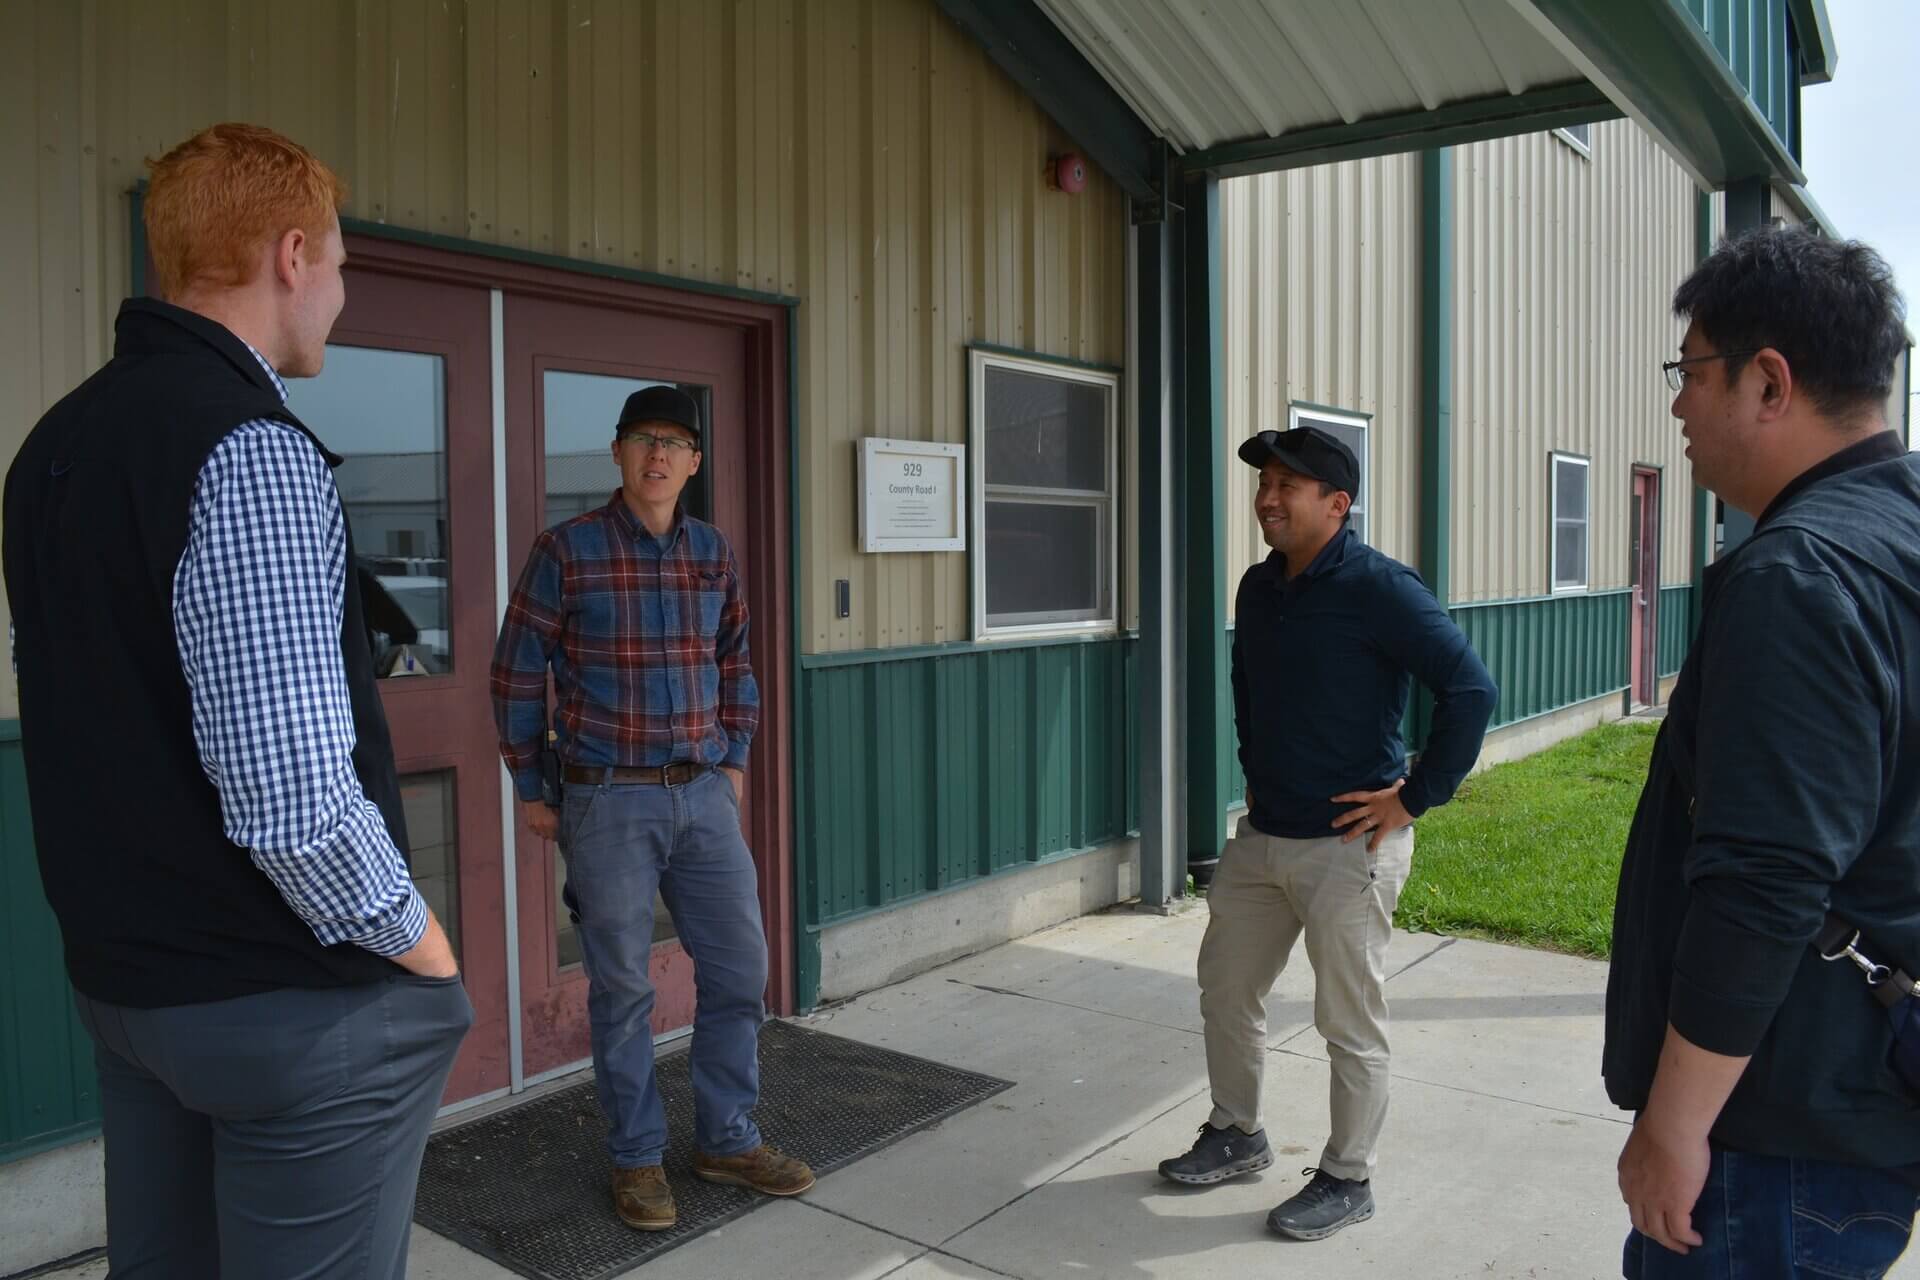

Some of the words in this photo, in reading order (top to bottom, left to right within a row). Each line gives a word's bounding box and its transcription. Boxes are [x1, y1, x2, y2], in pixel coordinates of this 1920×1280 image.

[903, 463, 922, 477] 929
[889, 484, 914, 496] County
[915, 485, 933, 495] Road
